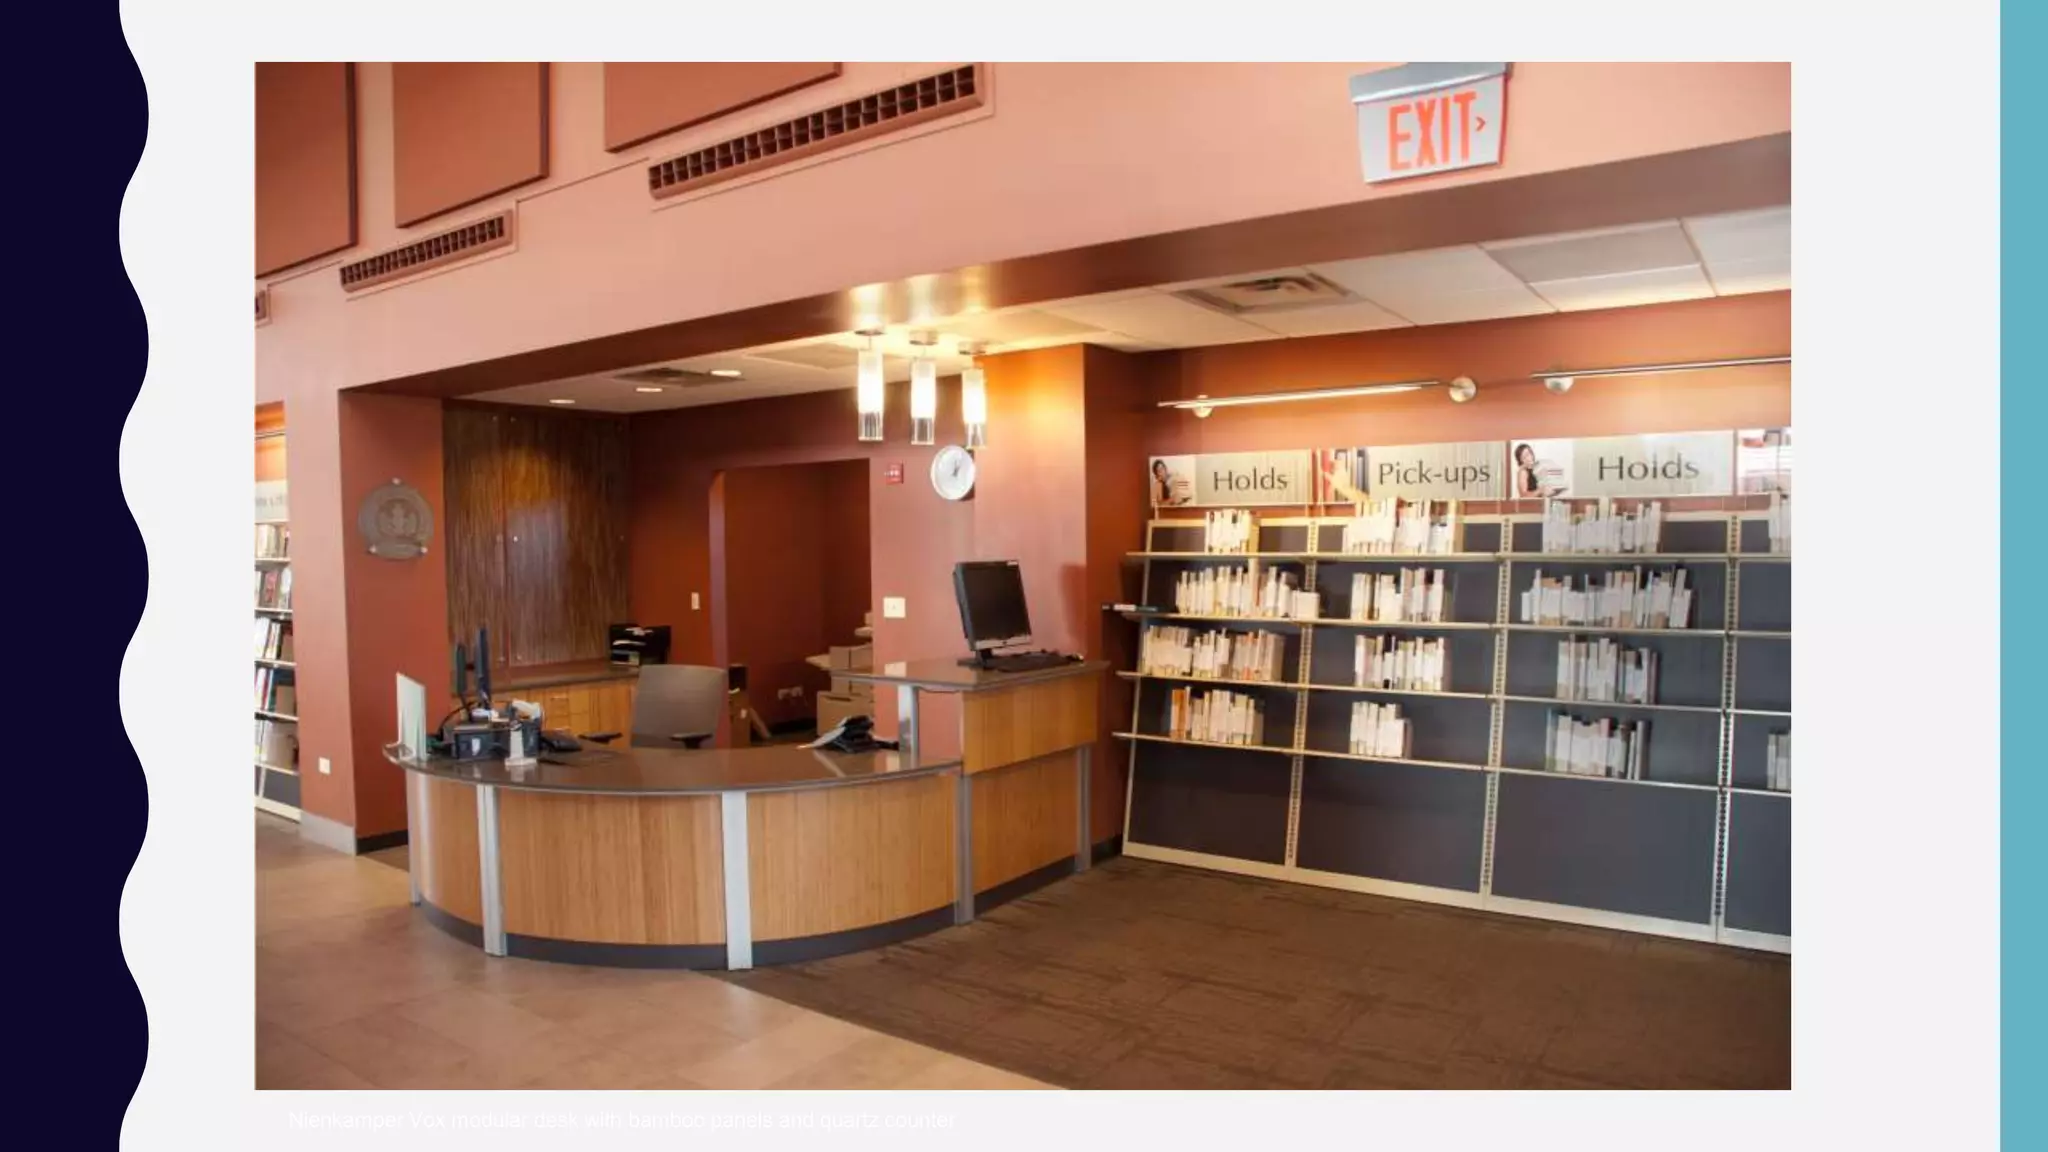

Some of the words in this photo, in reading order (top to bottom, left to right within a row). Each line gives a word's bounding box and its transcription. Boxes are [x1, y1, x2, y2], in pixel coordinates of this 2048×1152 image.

[1388, 91, 1477, 171] EXIT
[1213, 466, 1289, 492] Holds
[1379, 459, 1491, 491] Pick-ups
[1599, 451, 1700, 480] Holds
